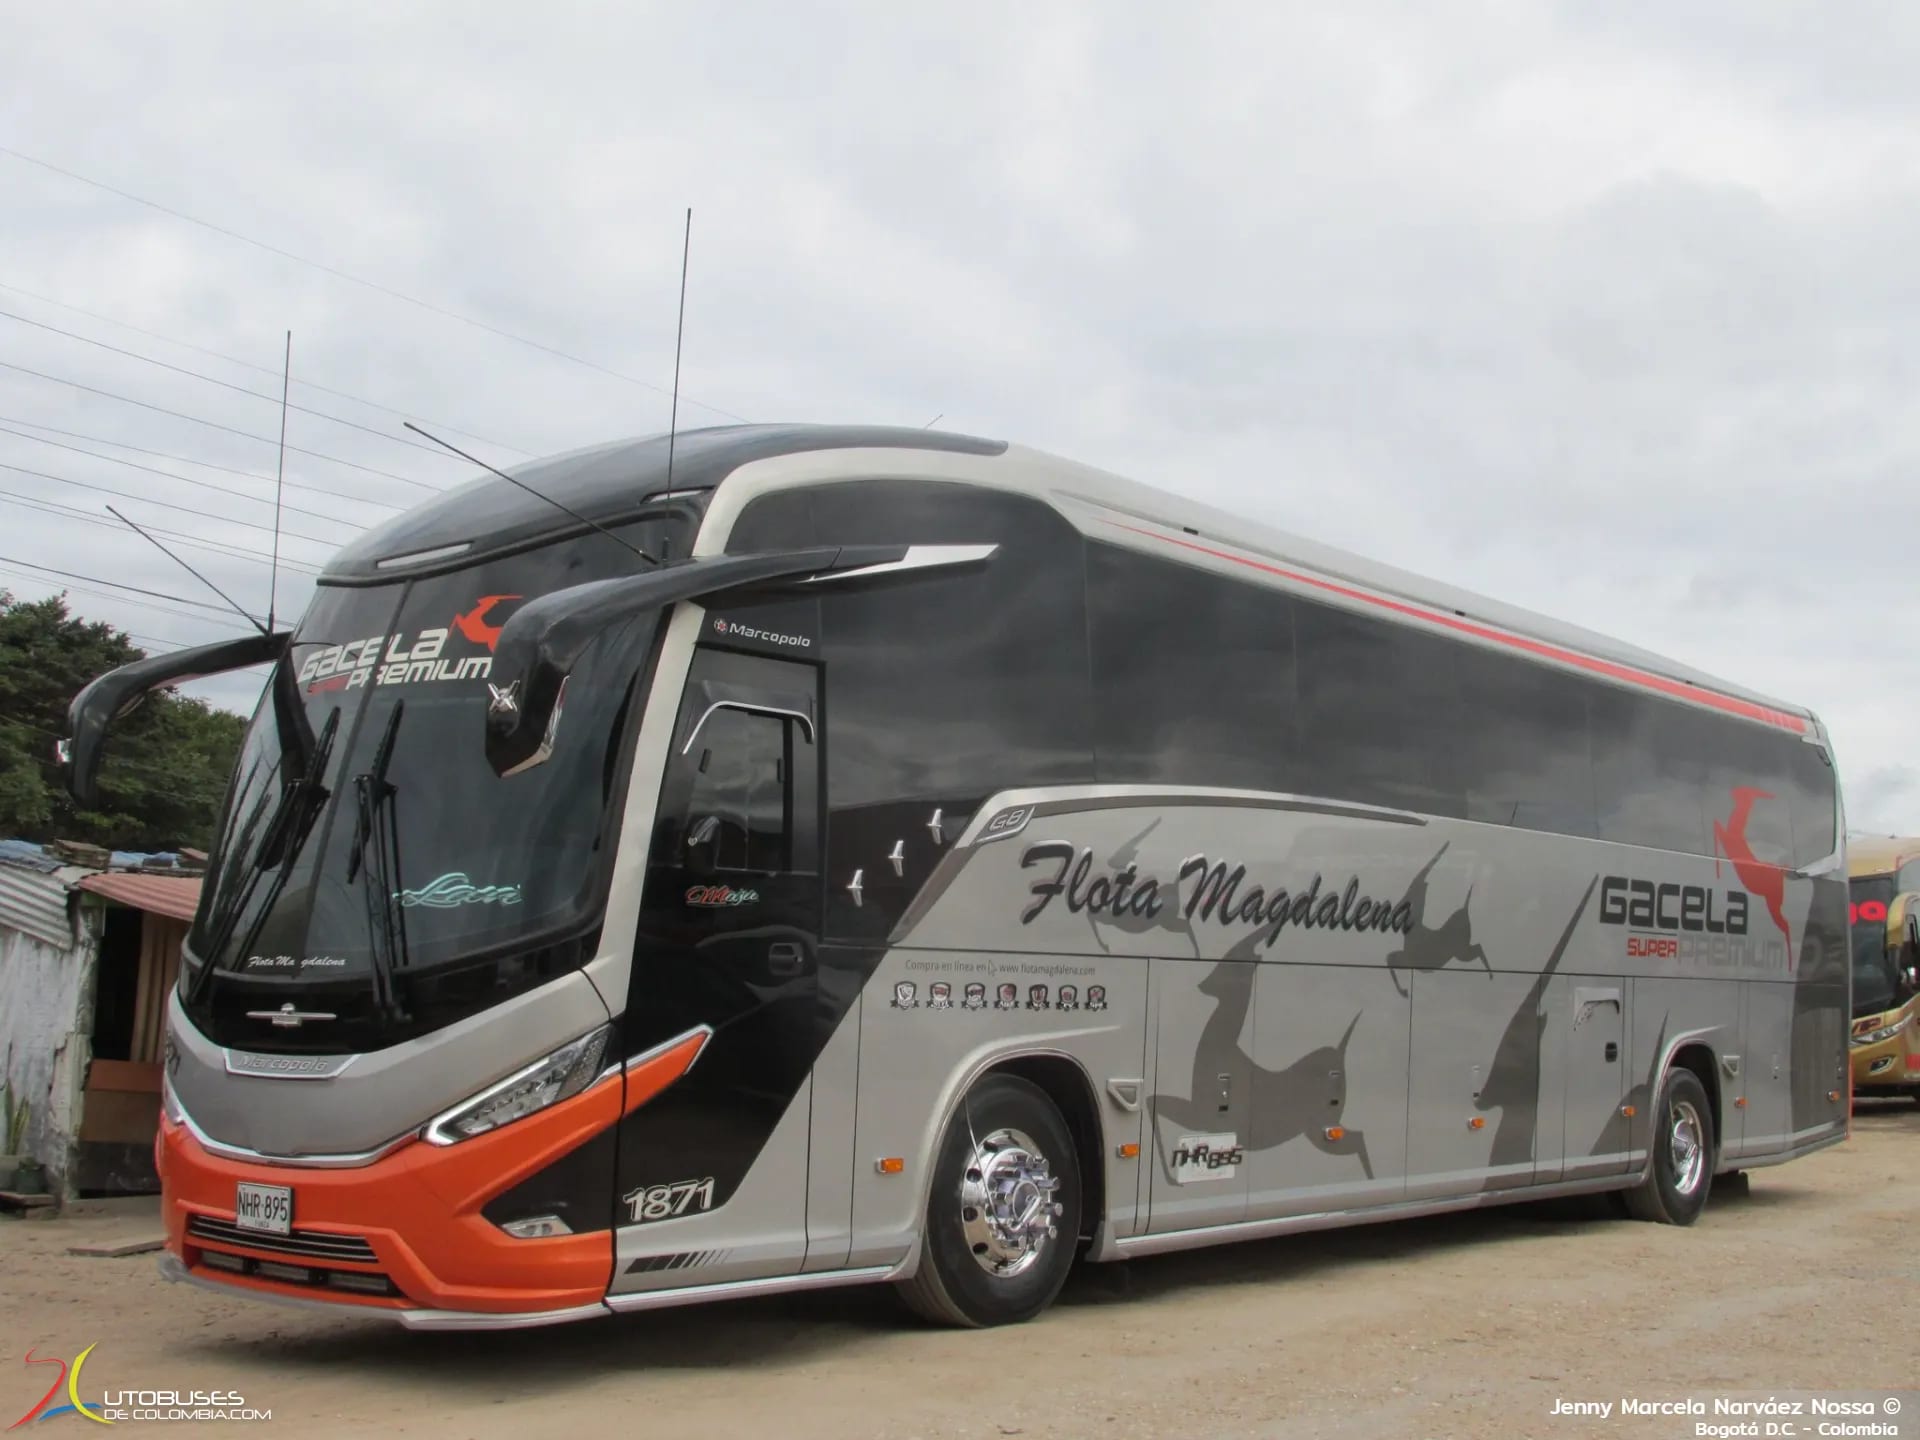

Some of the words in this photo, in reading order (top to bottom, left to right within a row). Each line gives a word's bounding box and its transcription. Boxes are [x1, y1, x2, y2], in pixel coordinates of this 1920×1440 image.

[729, 622, 811, 648] Marcopolo
[1020, 839, 1165, 926] Flota
[1178, 852, 1416, 949] Magdalena
[1626, 936, 1678, 958] SUPER
[905, 959, 939, 973] Compra
[238, 1054, 329, 1073] Marcopolo
[622, 1176, 715, 1222] 1871
